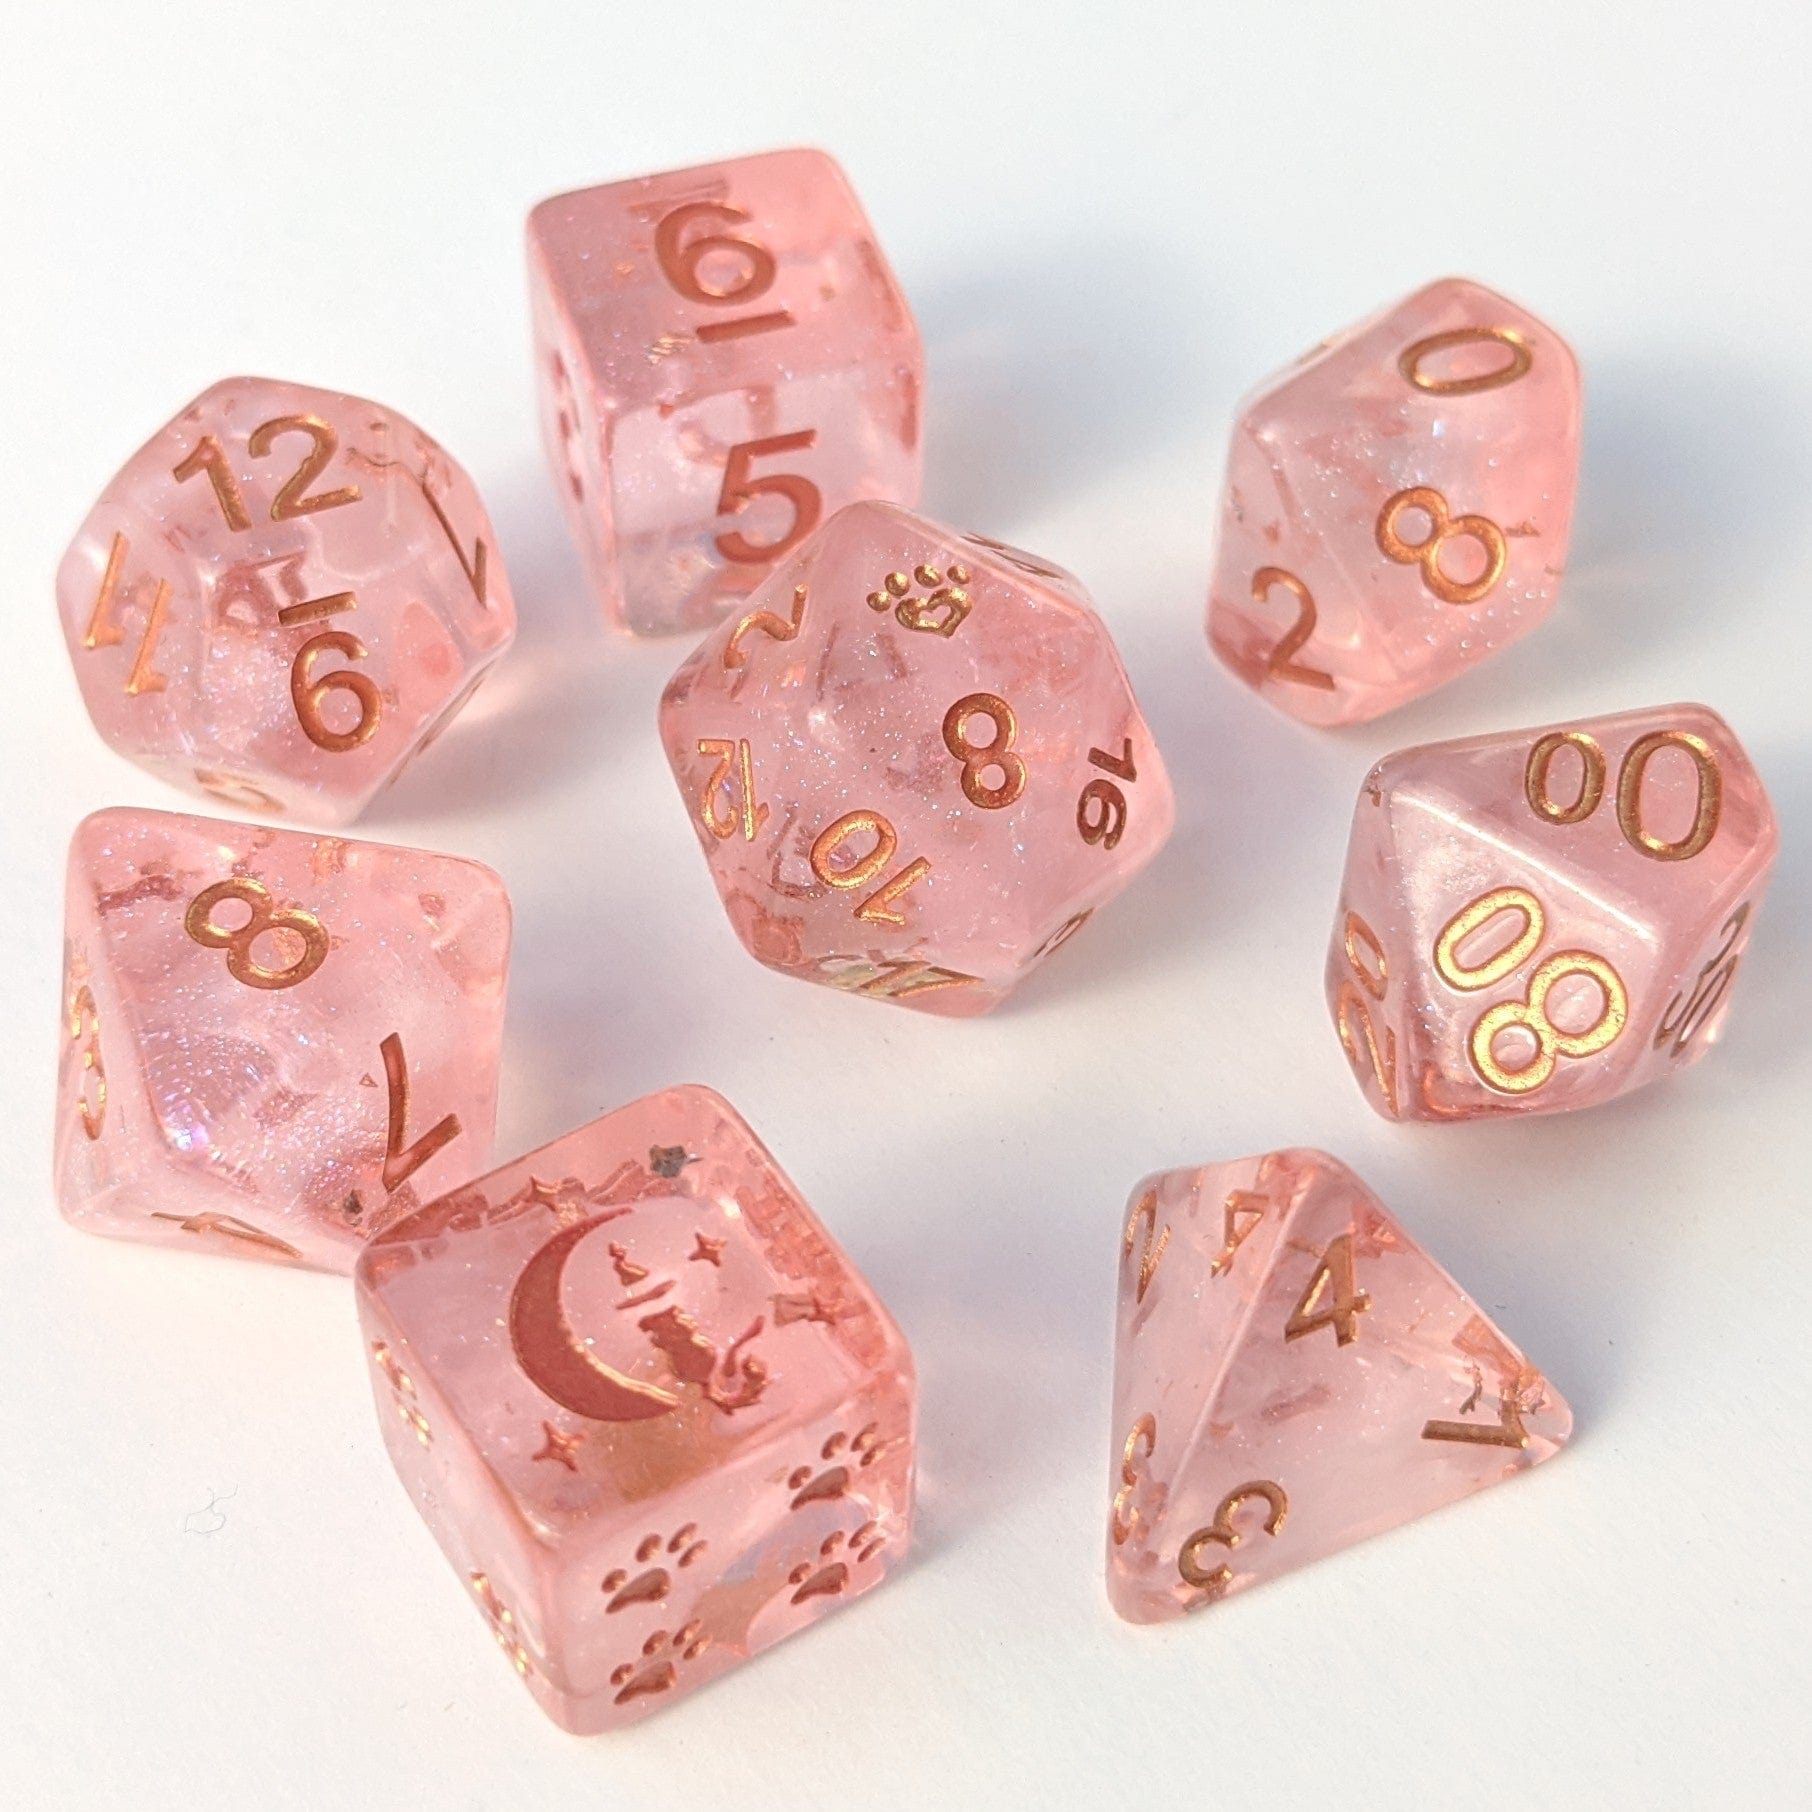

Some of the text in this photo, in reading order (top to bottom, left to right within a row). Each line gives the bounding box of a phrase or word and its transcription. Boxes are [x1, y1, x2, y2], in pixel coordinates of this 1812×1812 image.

[655, 202, 797, 343] 6
[1398, 327, 1533, 396] 0
[173, 414, 364, 532] 12
[714, 428, 824, 565] 5
[1375, 486, 1507, 604] 8
[723, 583, 808, 669] 2
[1252, 566, 1336, 691] 2
[697, 738, 769, 842] 12
[943, 692, 1027, 809] 8
[1076, 738, 1137, 851] 16
[1525, 731, 1721, 861] 00
[810, 809, 932, 926] 10
[184, 876, 330, 990] 8
[380, 1032, 462, 1194] 7
[1284, 1232, 1371, 1348] 4
[1111, 1411, 1156, 1546] 3
[1178, 1480, 1288, 1588] 3
